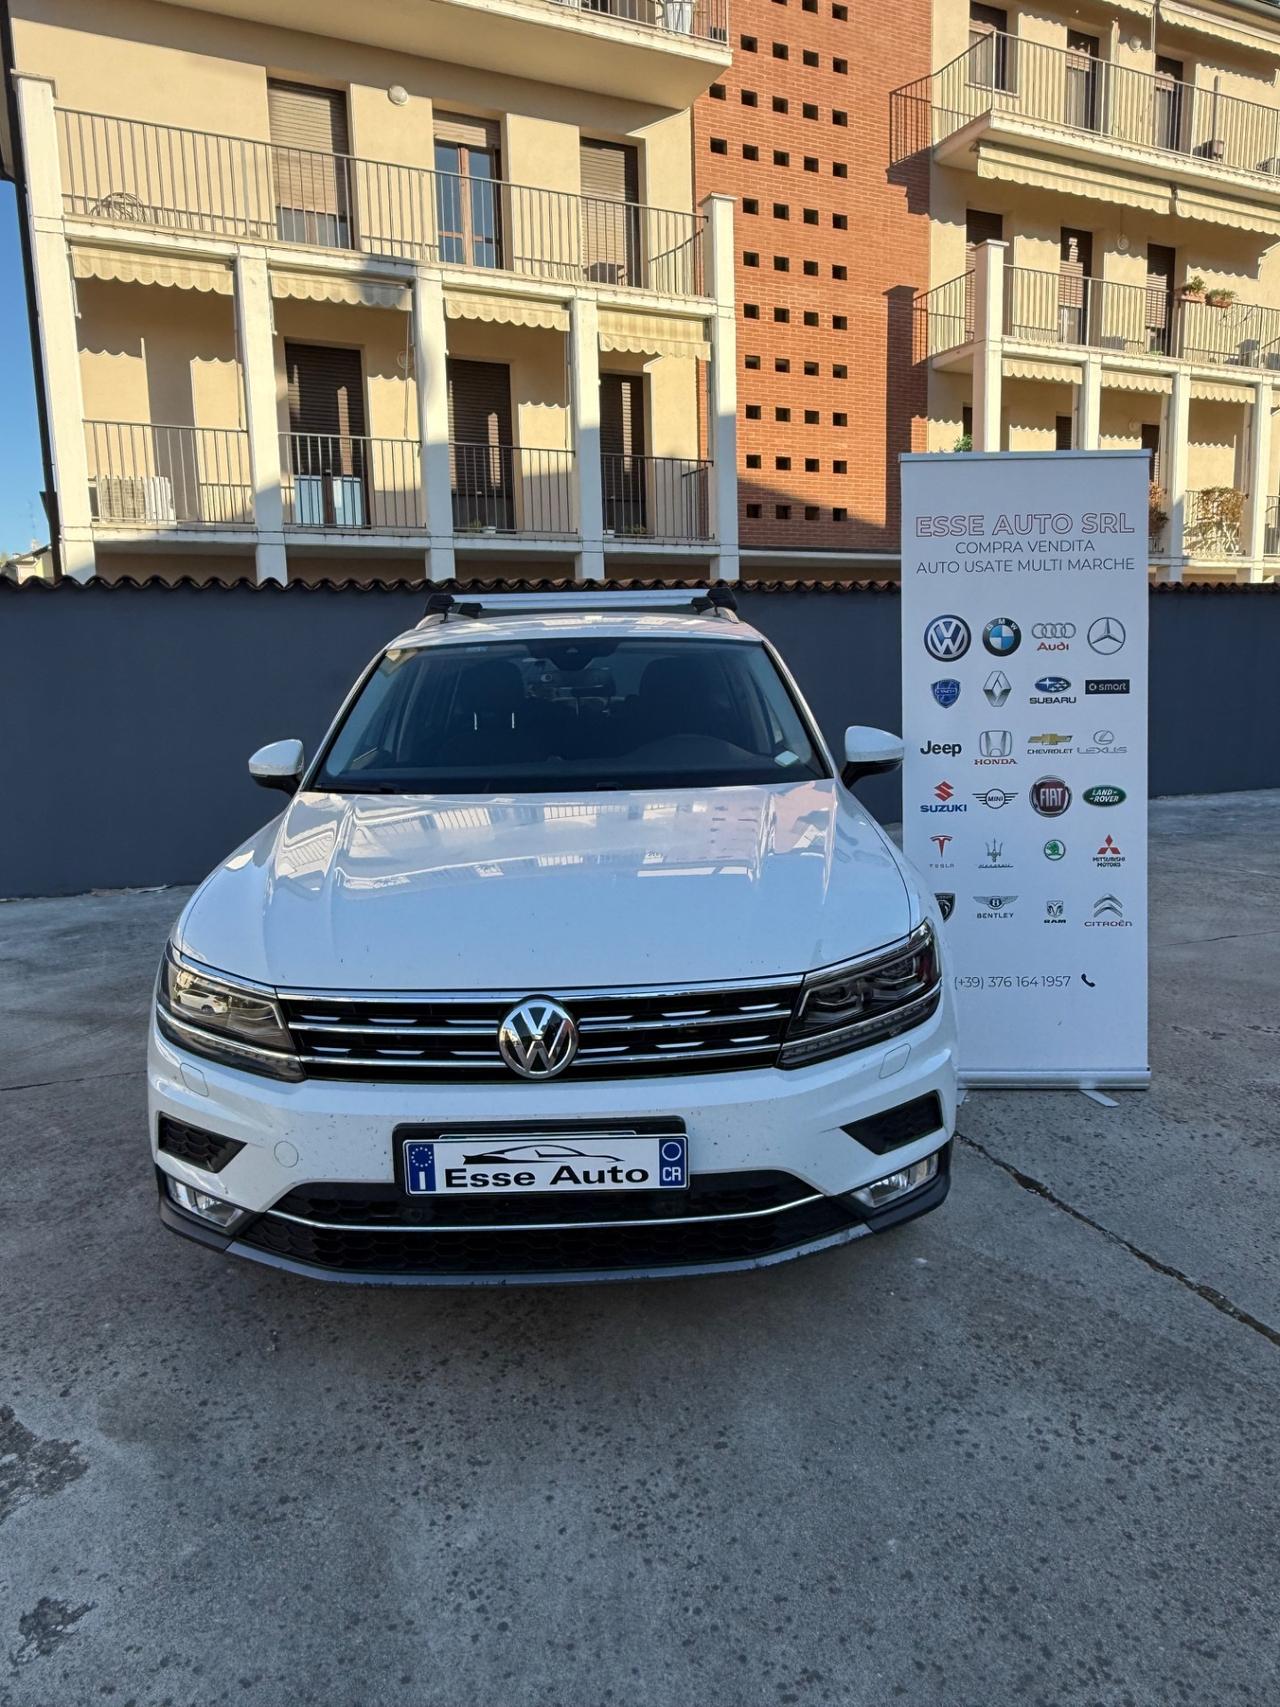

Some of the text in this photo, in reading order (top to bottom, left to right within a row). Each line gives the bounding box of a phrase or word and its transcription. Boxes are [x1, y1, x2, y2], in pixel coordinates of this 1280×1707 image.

[915, 512, 1135, 537] ESSE AUTO SRL
[955, 539, 1095, 554] COMPRA VENDITA
[916, 557, 1135, 574] AUTO USATE MULTI MARCHE
[1036, 642, 1070, 651] Audi
[1098, 682, 1127, 691] smart
[1029, 696, 1077, 704] SUBARU
[920, 740, 962, 757] Jeep
[1077, 746, 1128, 754] LEXUS
[1039, 787, 1064, 807] FIAT
[1093, 795, 1119, 803] ROVER
[920, 803, 967, 813] SUZUKI
[954, 975, 1071, 990] (+39) 376 164 1957
[445, 1165, 650, 1189] Esse Auto
